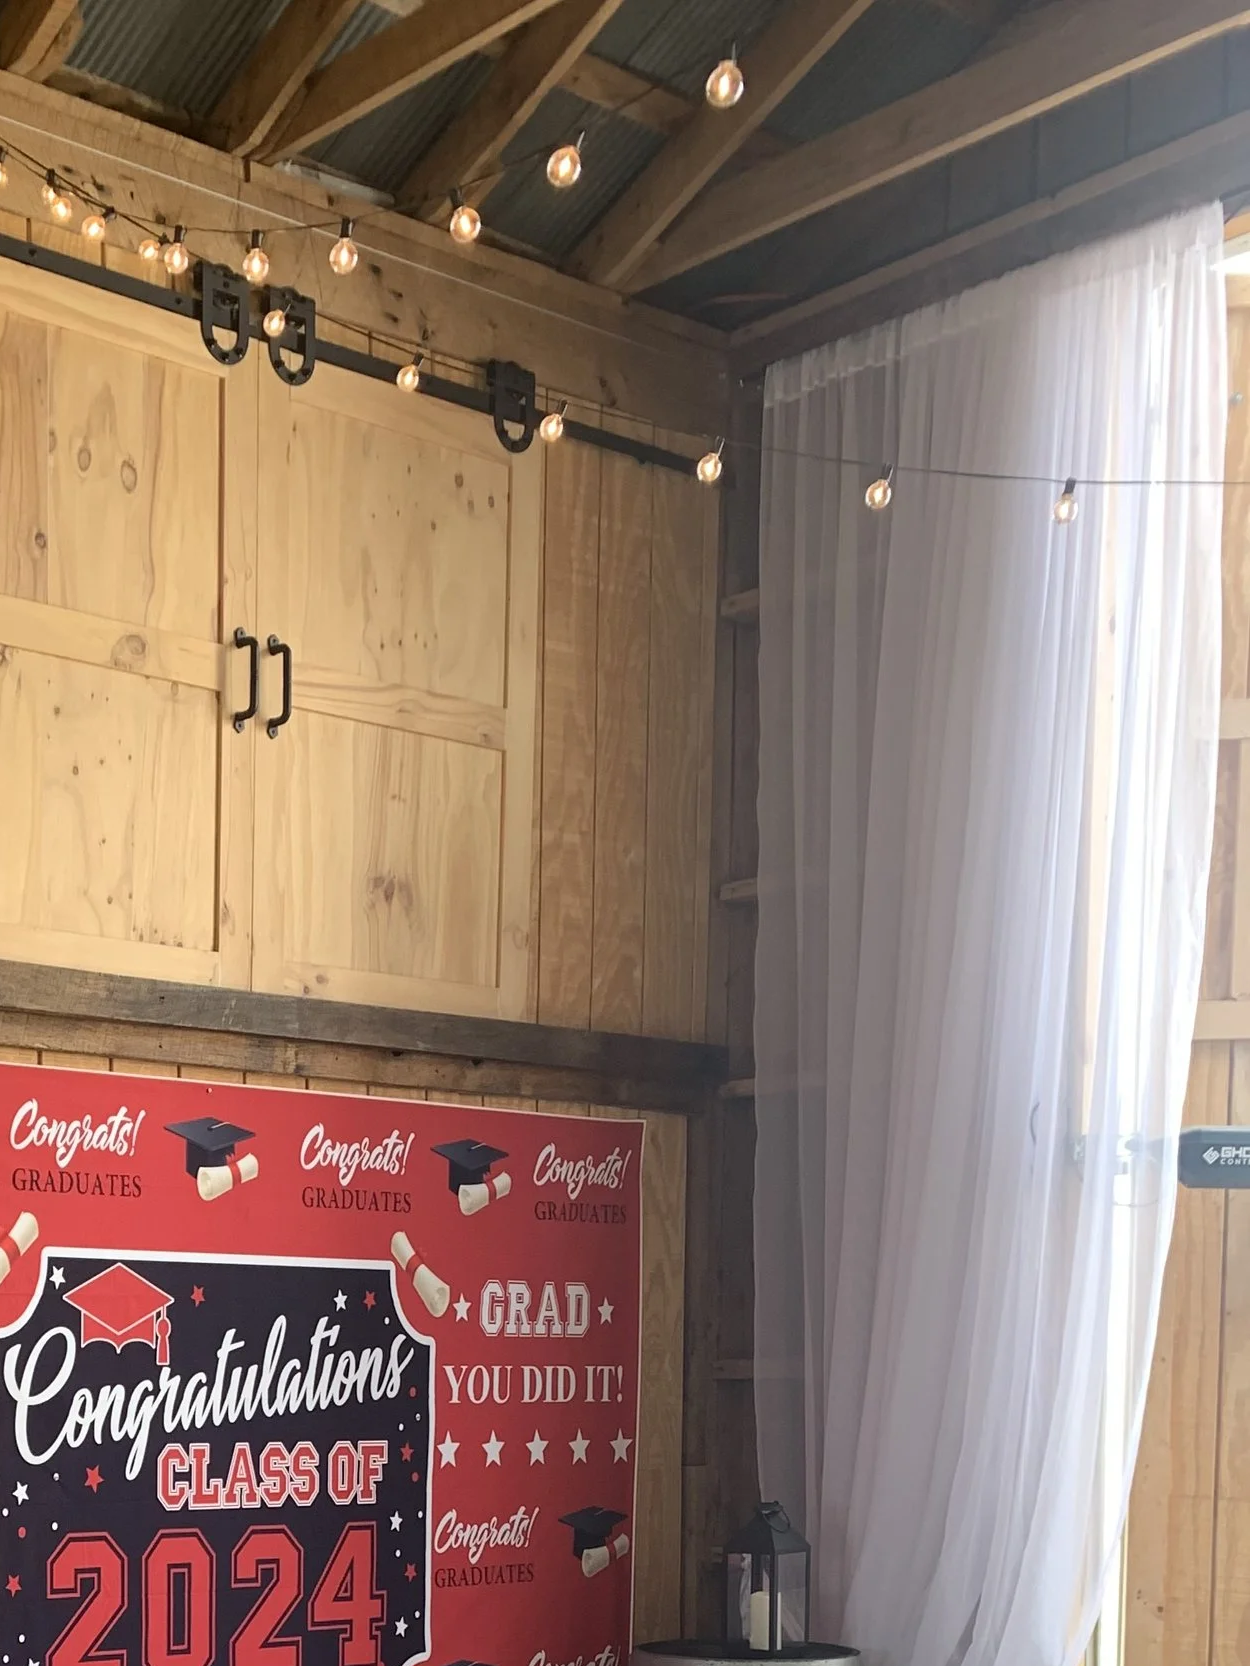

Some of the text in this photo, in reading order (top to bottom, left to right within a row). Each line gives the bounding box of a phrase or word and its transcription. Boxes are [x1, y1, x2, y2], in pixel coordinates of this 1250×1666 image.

[9, 1098, 146, 1168] Congrats!
[299, 1122, 416, 1186] Congrats!
[11, 1167, 142, 1198] GRADUATES
[301, 1185, 412, 1214] GRADUATES
[533, 1142, 633, 1200] Congrats!
[534, 1199, 627, 1225] GRADUATES
[479, 1279, 591, 1338] GRAD
[2, 1314, 414, 1482] Congratulations
[442, 1364, 624, 1405] YOU DID IT!
[156, 1439, 389, 1512] CLASS OF
[434, 1505, 540, 1564] Congrats!
[434, 1562, 535, 1589] GRADUATES
